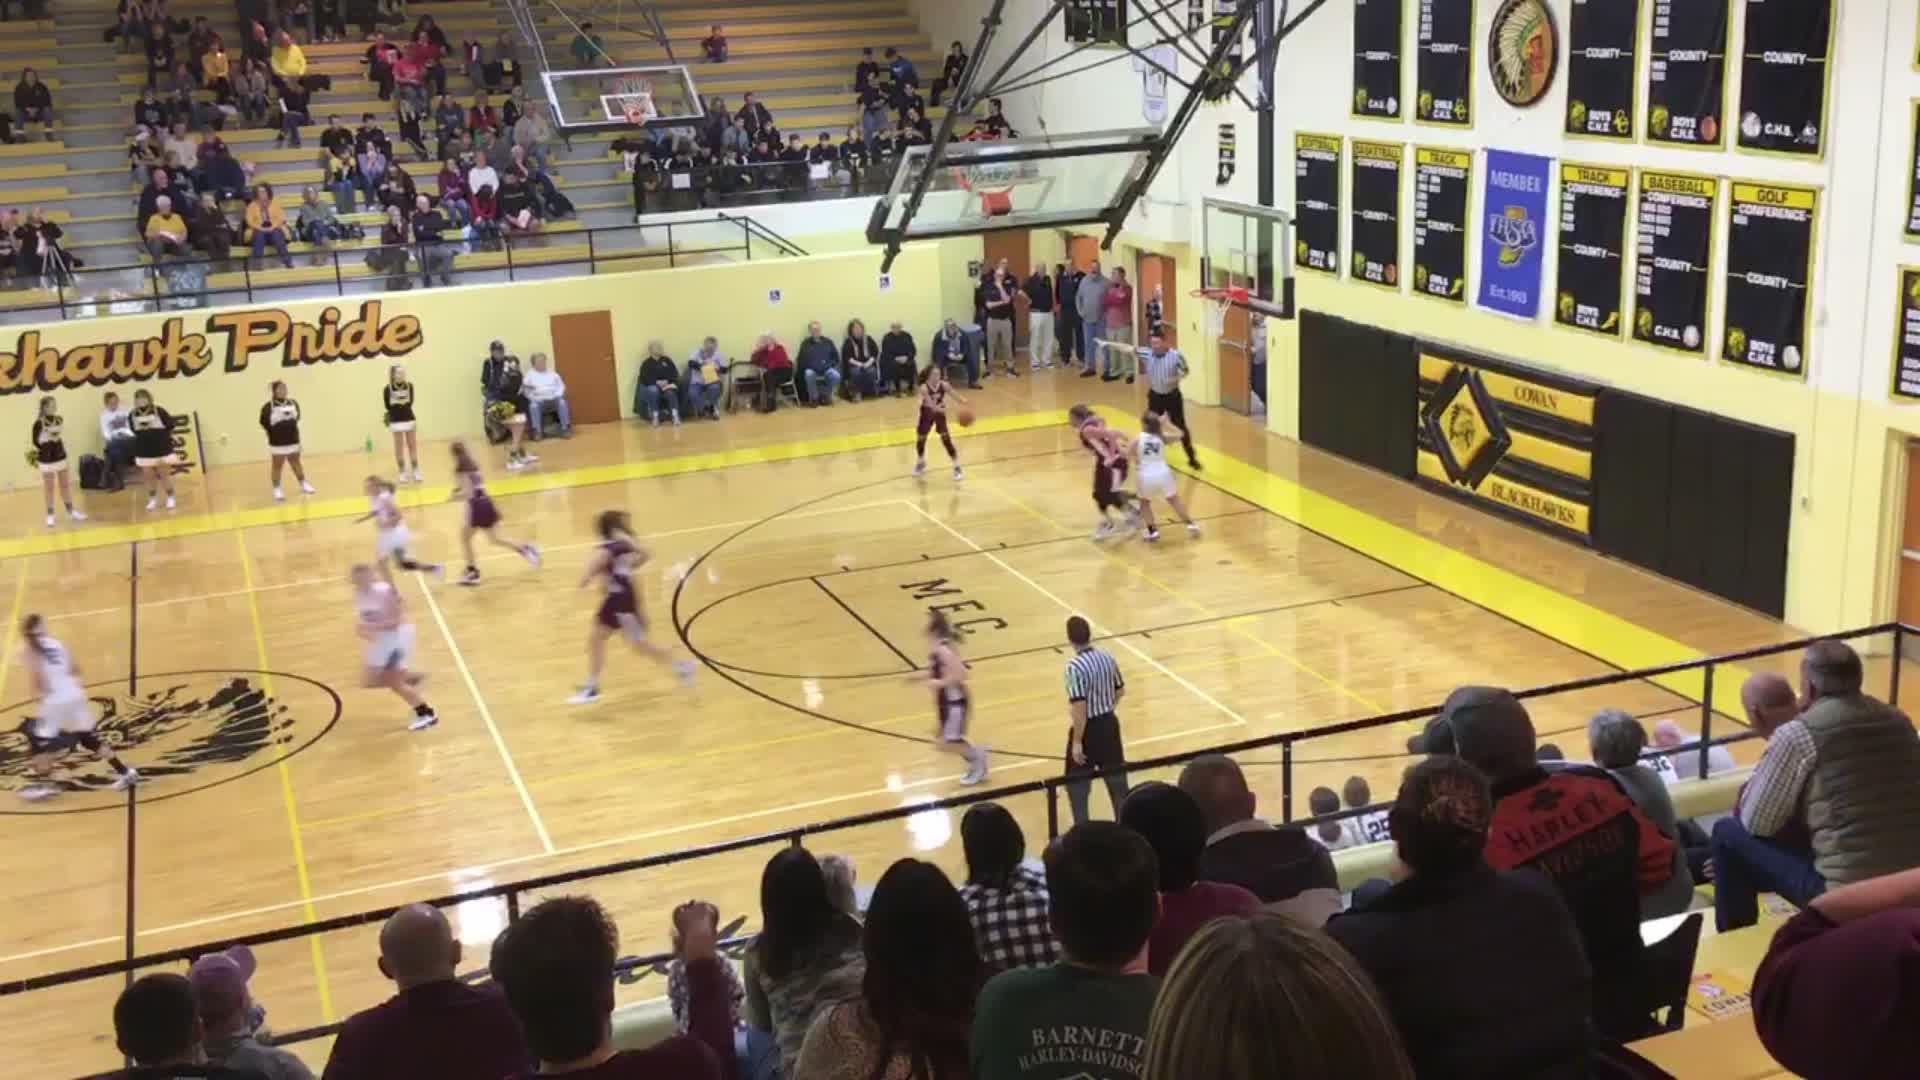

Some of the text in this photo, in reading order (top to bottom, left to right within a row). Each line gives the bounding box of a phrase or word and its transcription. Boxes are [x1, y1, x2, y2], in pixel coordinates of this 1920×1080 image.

[1585, 48, 1620, 59] COUNTY
[1669, 50, 1708, 61] COUNTY
[1763, 51, 1807, 65] COUNTY
[1490, 169, 1541, 193] MEMBER
[1578, 169, 1609, 183] TRACK
[1649, 175, 1706, 195] BASEBALL
[1567, 182, 1621, 198] CONFERENCE
[1757, 189, 1789, 204] GOLF
[1646, 191, 1708, 209] CONFERENCE
[1738, 203, 1808, 221] CONFERENCE
[1574, 244, 1607, 258] COUNTY
[1654, 257, 1692, 272] COUNTY
[1746, 271, 1789, 289] COUNTY
[206, 300, 423, 373] Pride
[1513, 386, 1557, 410] COWAN
[1143, 440, 1161, 457] 24
[1491, 482, 1576, 524] BLACKHAWKS
[1504, 790, 1605, 853] HARLEY
[1031, 1025, 1146, 1055] BARNETT
